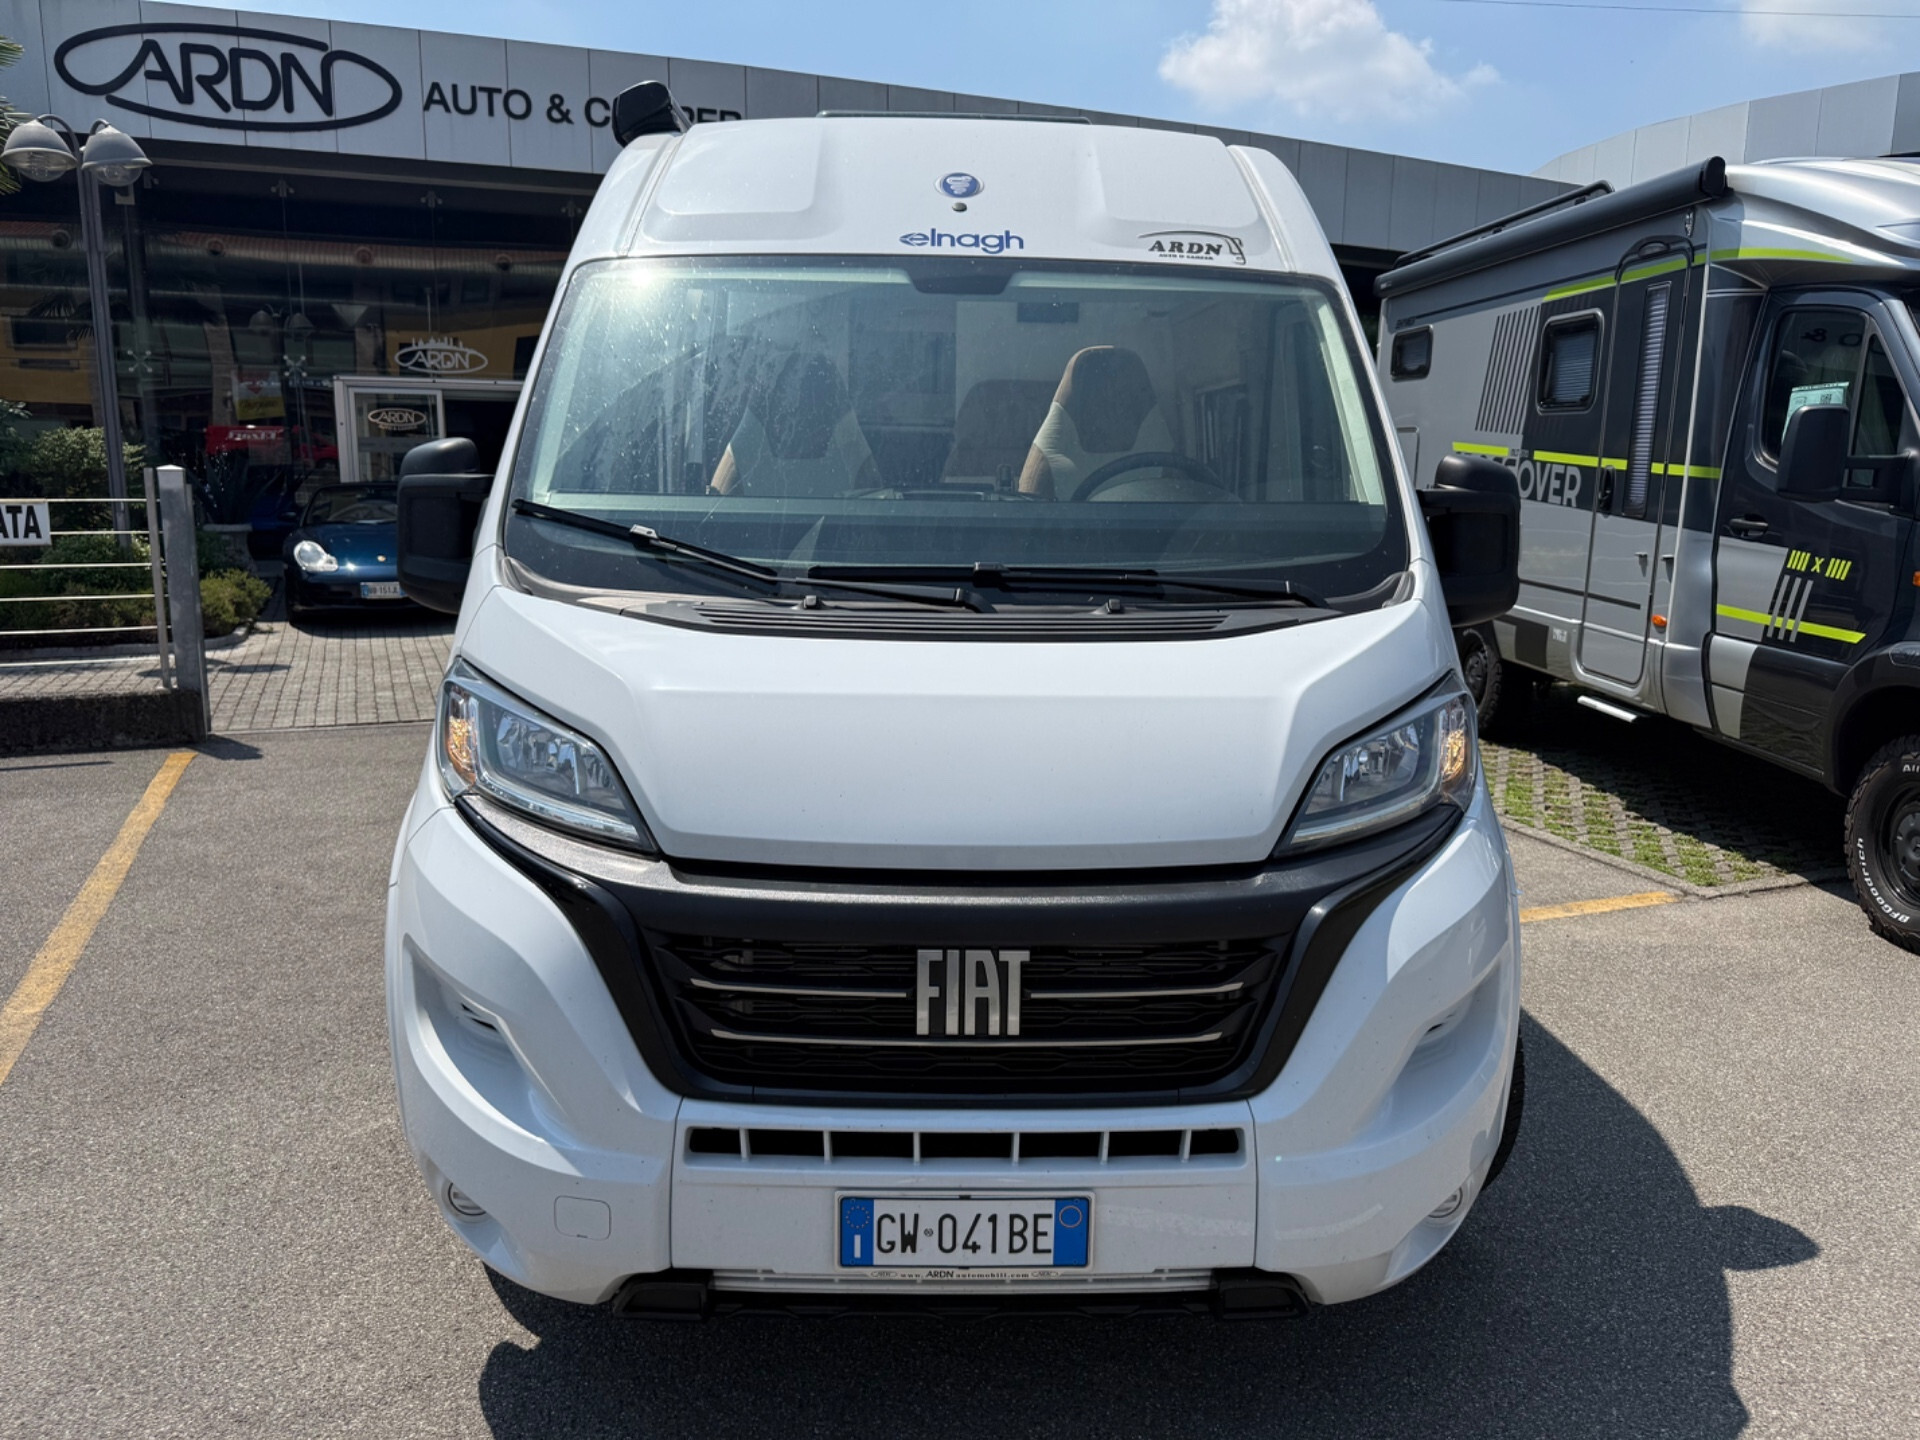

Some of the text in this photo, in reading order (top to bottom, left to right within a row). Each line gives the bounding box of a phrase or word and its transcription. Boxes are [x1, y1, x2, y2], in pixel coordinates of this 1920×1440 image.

[78, 33, 360, 122] ARDN
[423, 81, 532, 120] AUTO
[546, 93, 574, 124] &
[899, 228, 1024, 254] elnagh
[1148, 240, 1223, 256] ARDN
[402, 348, 478, 371] ARDN
[374, 409, 419, 424] ARDN
[916, 949, 1031, 1036] FIAT
[876, 1213, 920, 1254] GW
[937, 1213, 1054, 1255] 041BE
